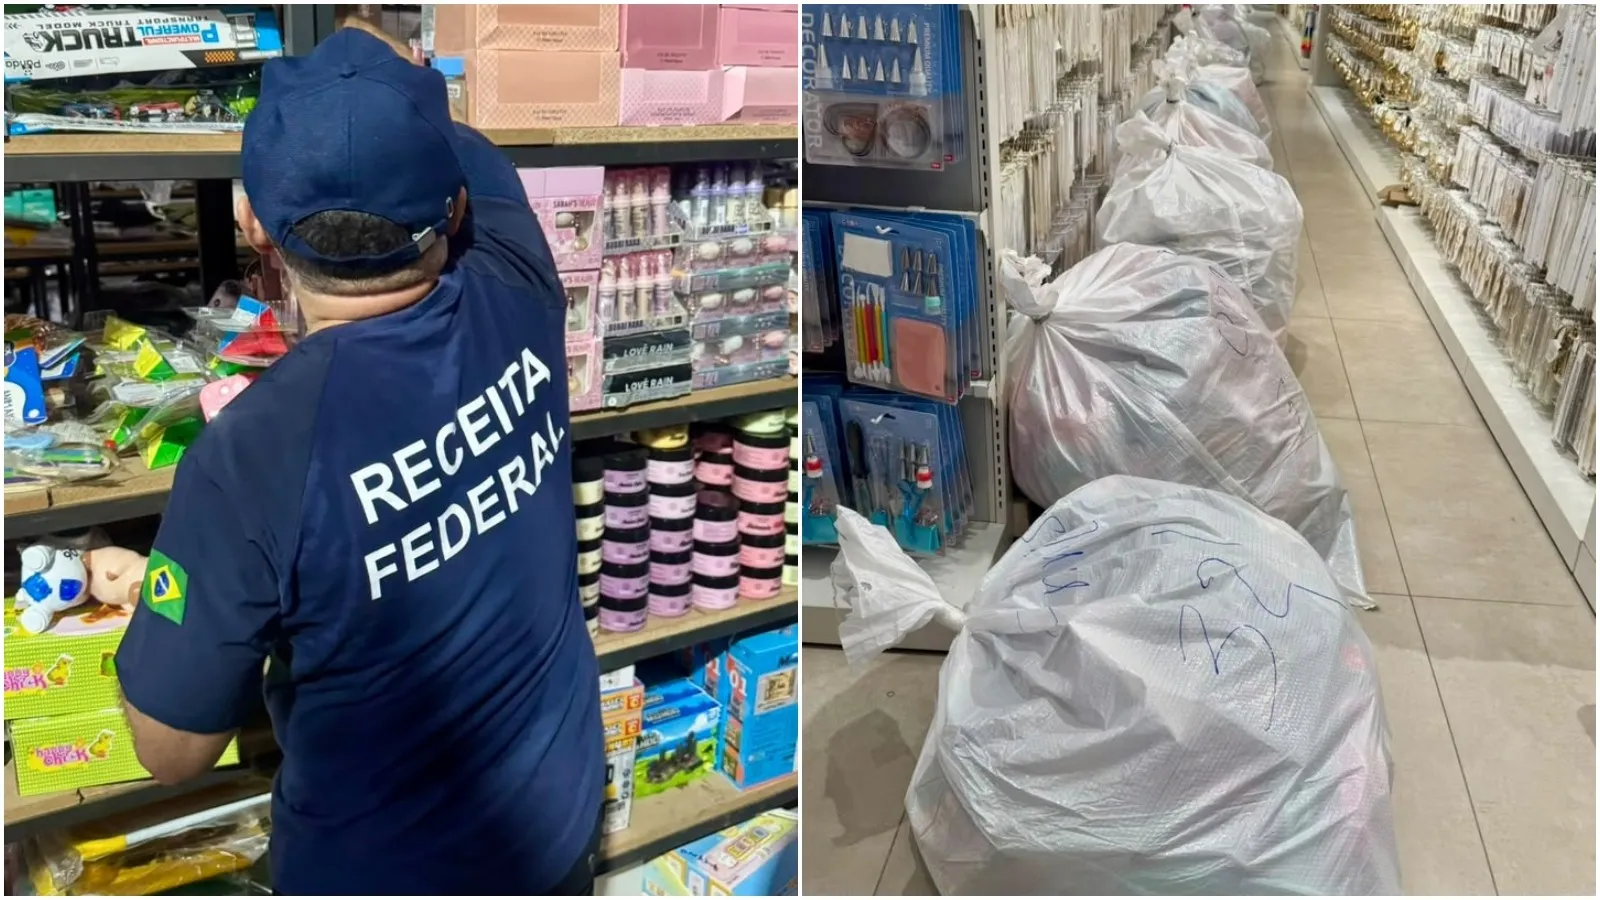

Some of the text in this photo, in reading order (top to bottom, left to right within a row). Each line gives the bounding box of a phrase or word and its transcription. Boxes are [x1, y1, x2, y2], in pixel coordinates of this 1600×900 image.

[37, 15, 209, 30] TRANSPORT TRUCK MODEL
[44, 22, 220, 52] POWERFUL TRUCK
[802, 12, 823, 149] DECORATOR
[650, 343, 675, 354] RAIN
[650, 376, 674, 387] RAIN
[350, 347, 551, 525] RECEITA
[364, 411, 565, 600] FEDERAL
